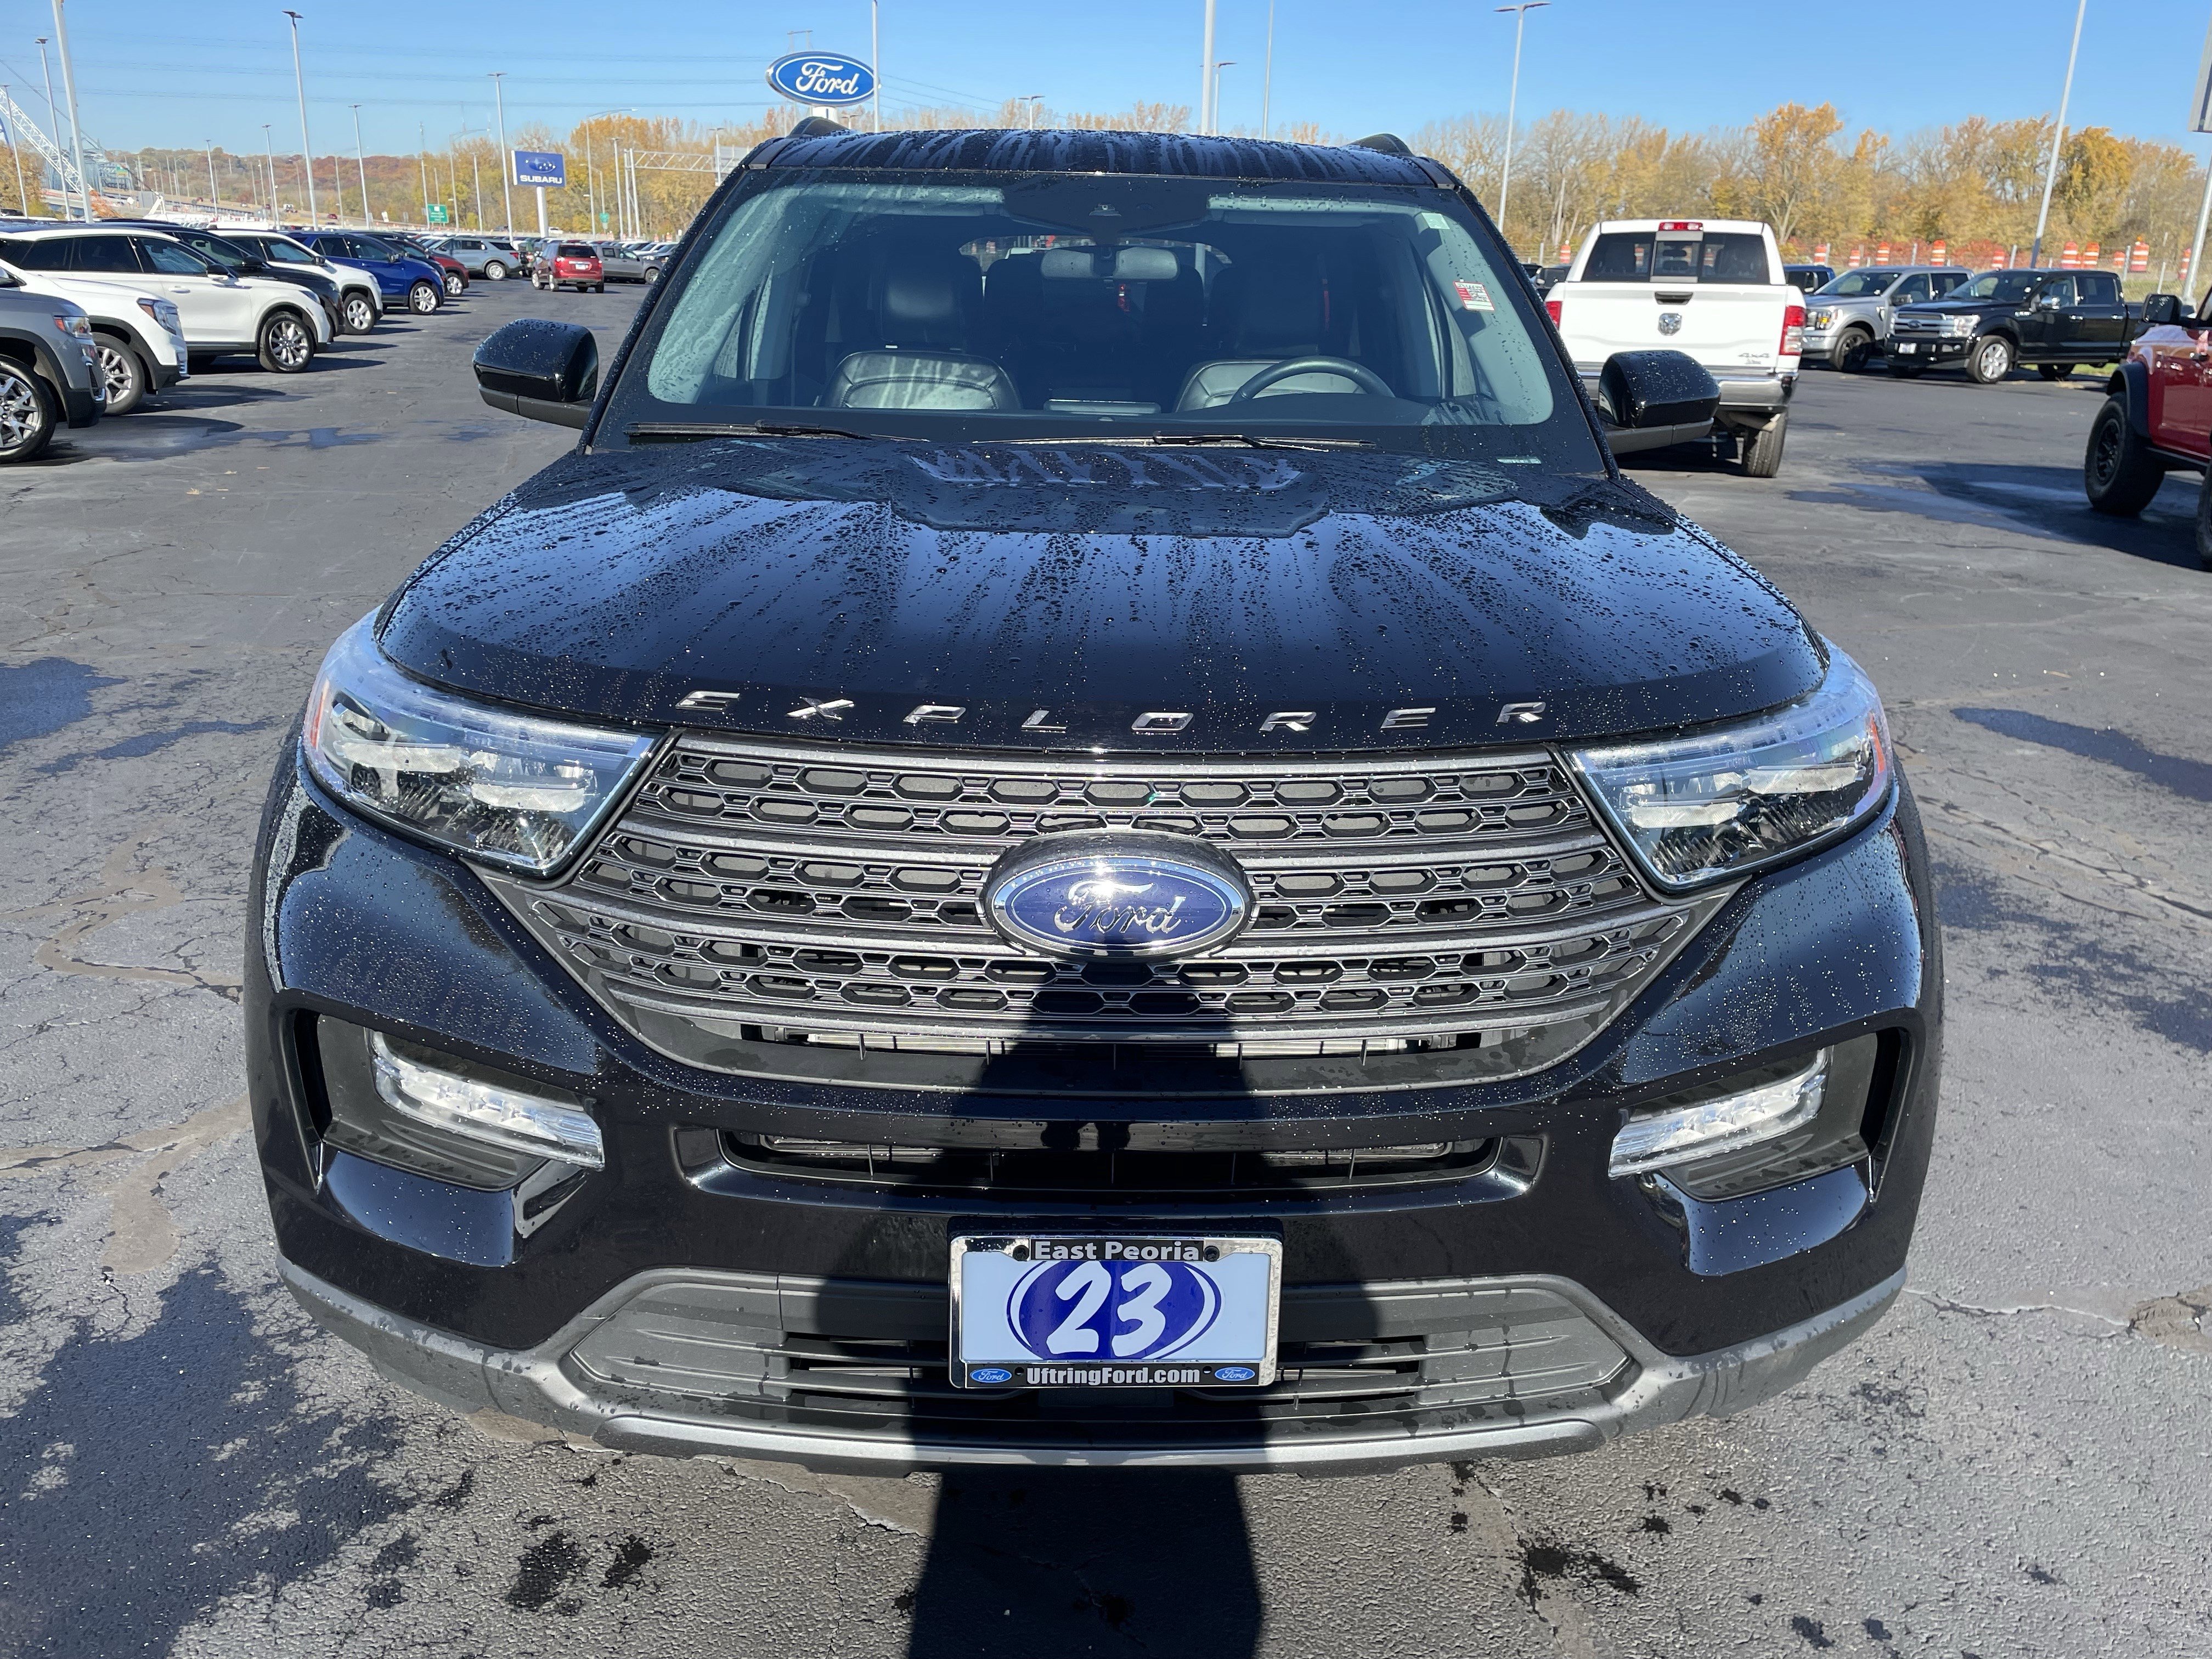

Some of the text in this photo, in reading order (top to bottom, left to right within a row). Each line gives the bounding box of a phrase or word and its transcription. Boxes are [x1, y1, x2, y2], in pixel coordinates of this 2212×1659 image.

[795, 62, 861, 95] Ford
[520, 174, 563, 184] SUBARU
[675, 690, 1547, 735] EXPLORER
[1054, 879, 1187, 933] Ford
[1035, 1241, 1199, 1260] East Peoria
[1046, 1260, 1172, 1357] 23
[978, 1367, 1248, 1386] Ford UftringFord.com Ford
